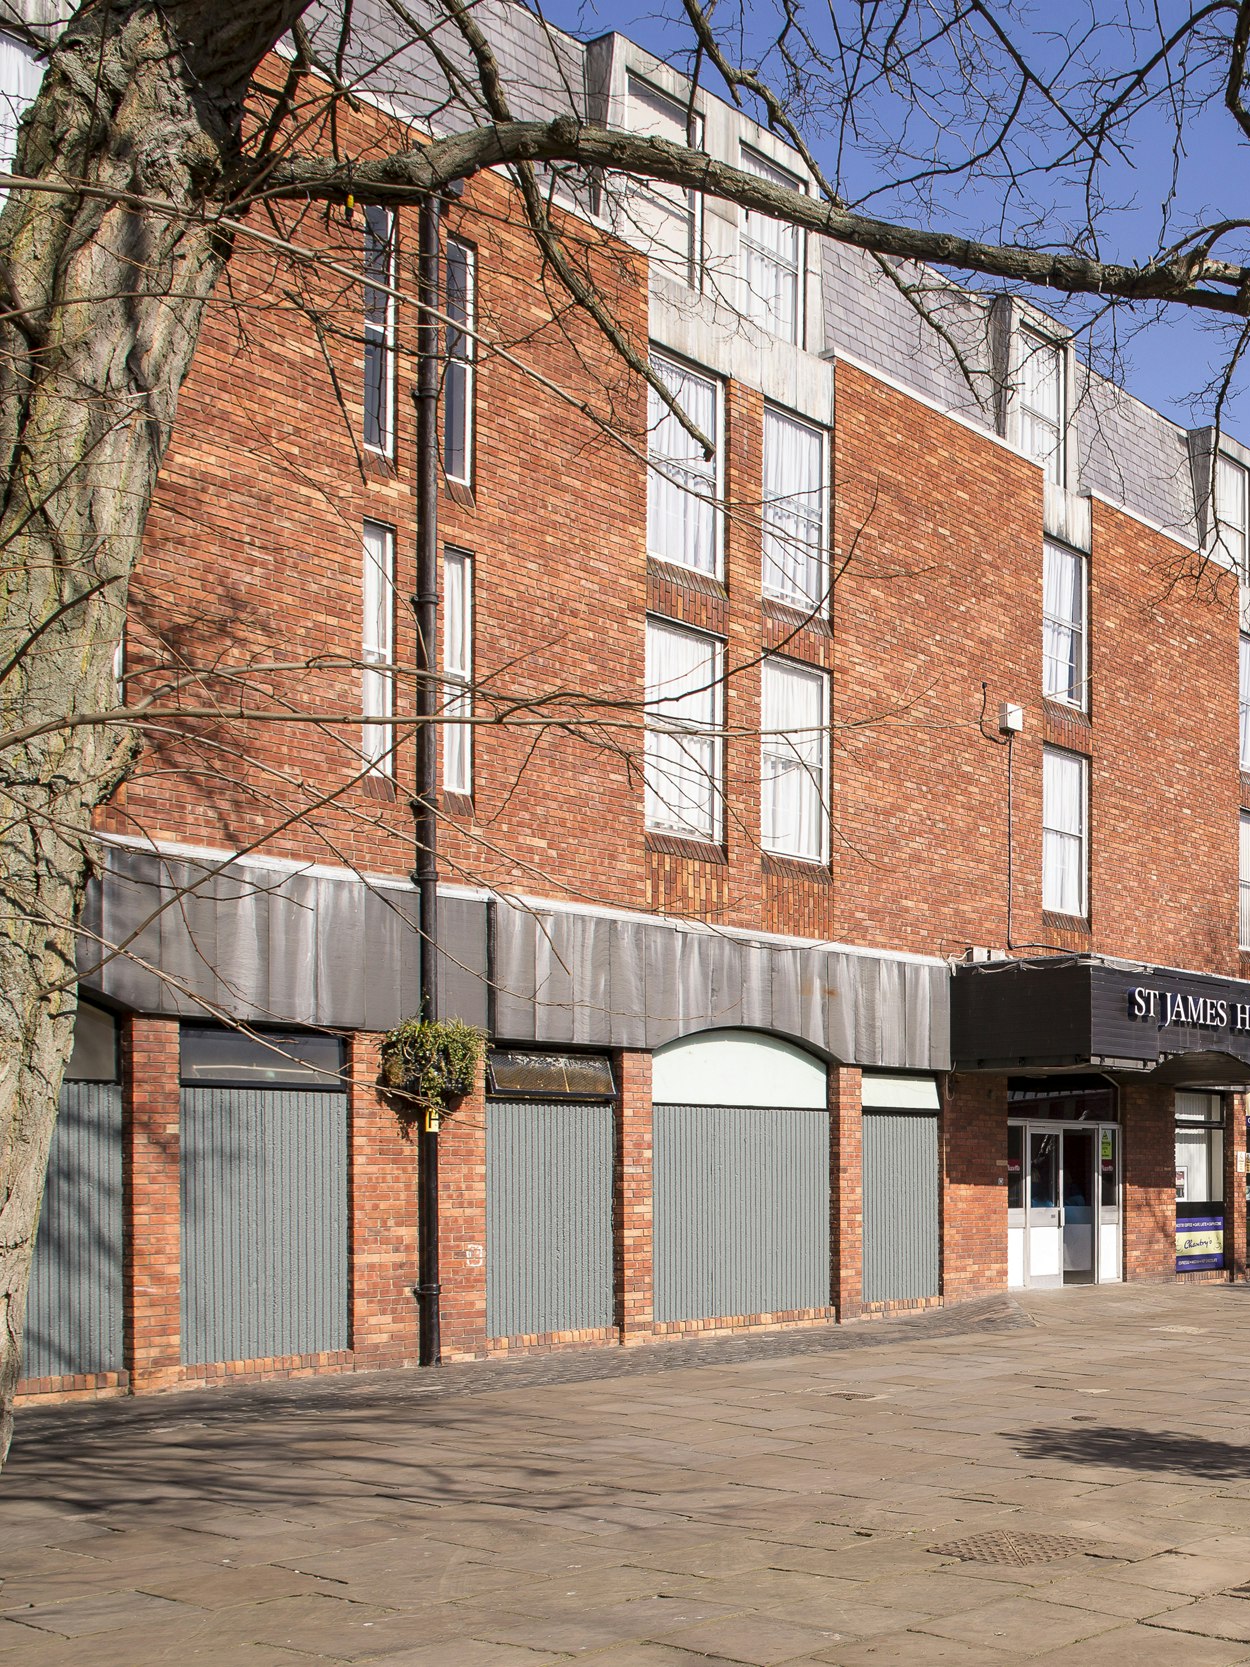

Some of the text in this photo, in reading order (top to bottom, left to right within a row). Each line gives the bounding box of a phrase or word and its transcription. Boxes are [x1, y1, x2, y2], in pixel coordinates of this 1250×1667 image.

[1134, 987, 1159, 1017] ST
[1165, 992, 1227, 1027] JAMES
[1184, 1237, 1212, 1249] Chantry's
